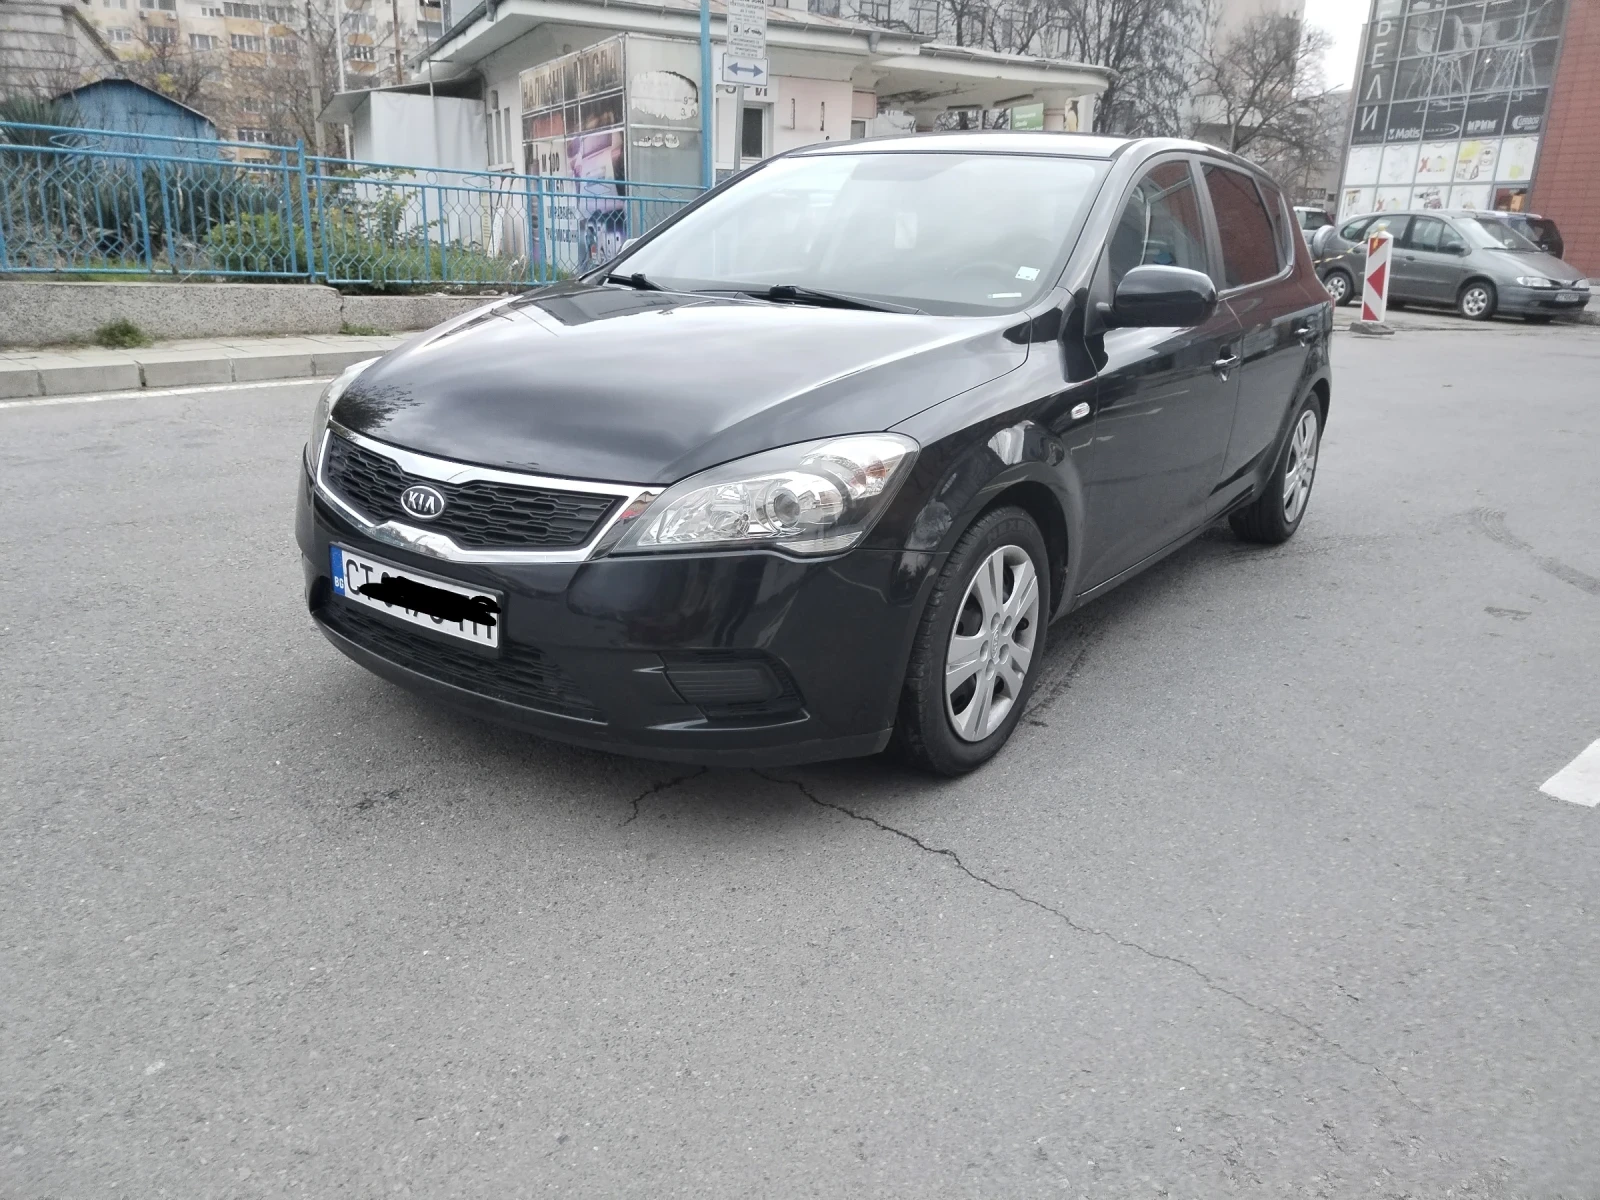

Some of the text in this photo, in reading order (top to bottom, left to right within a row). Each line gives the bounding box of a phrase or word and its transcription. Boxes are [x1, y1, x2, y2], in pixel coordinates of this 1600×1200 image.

[1361, 0, 1392, 131] БЕЛИ
[1395, 127, 1421, 139] Matis
[407, 490, 435, 514] KIA
[335, 576, 344, 589] BG
